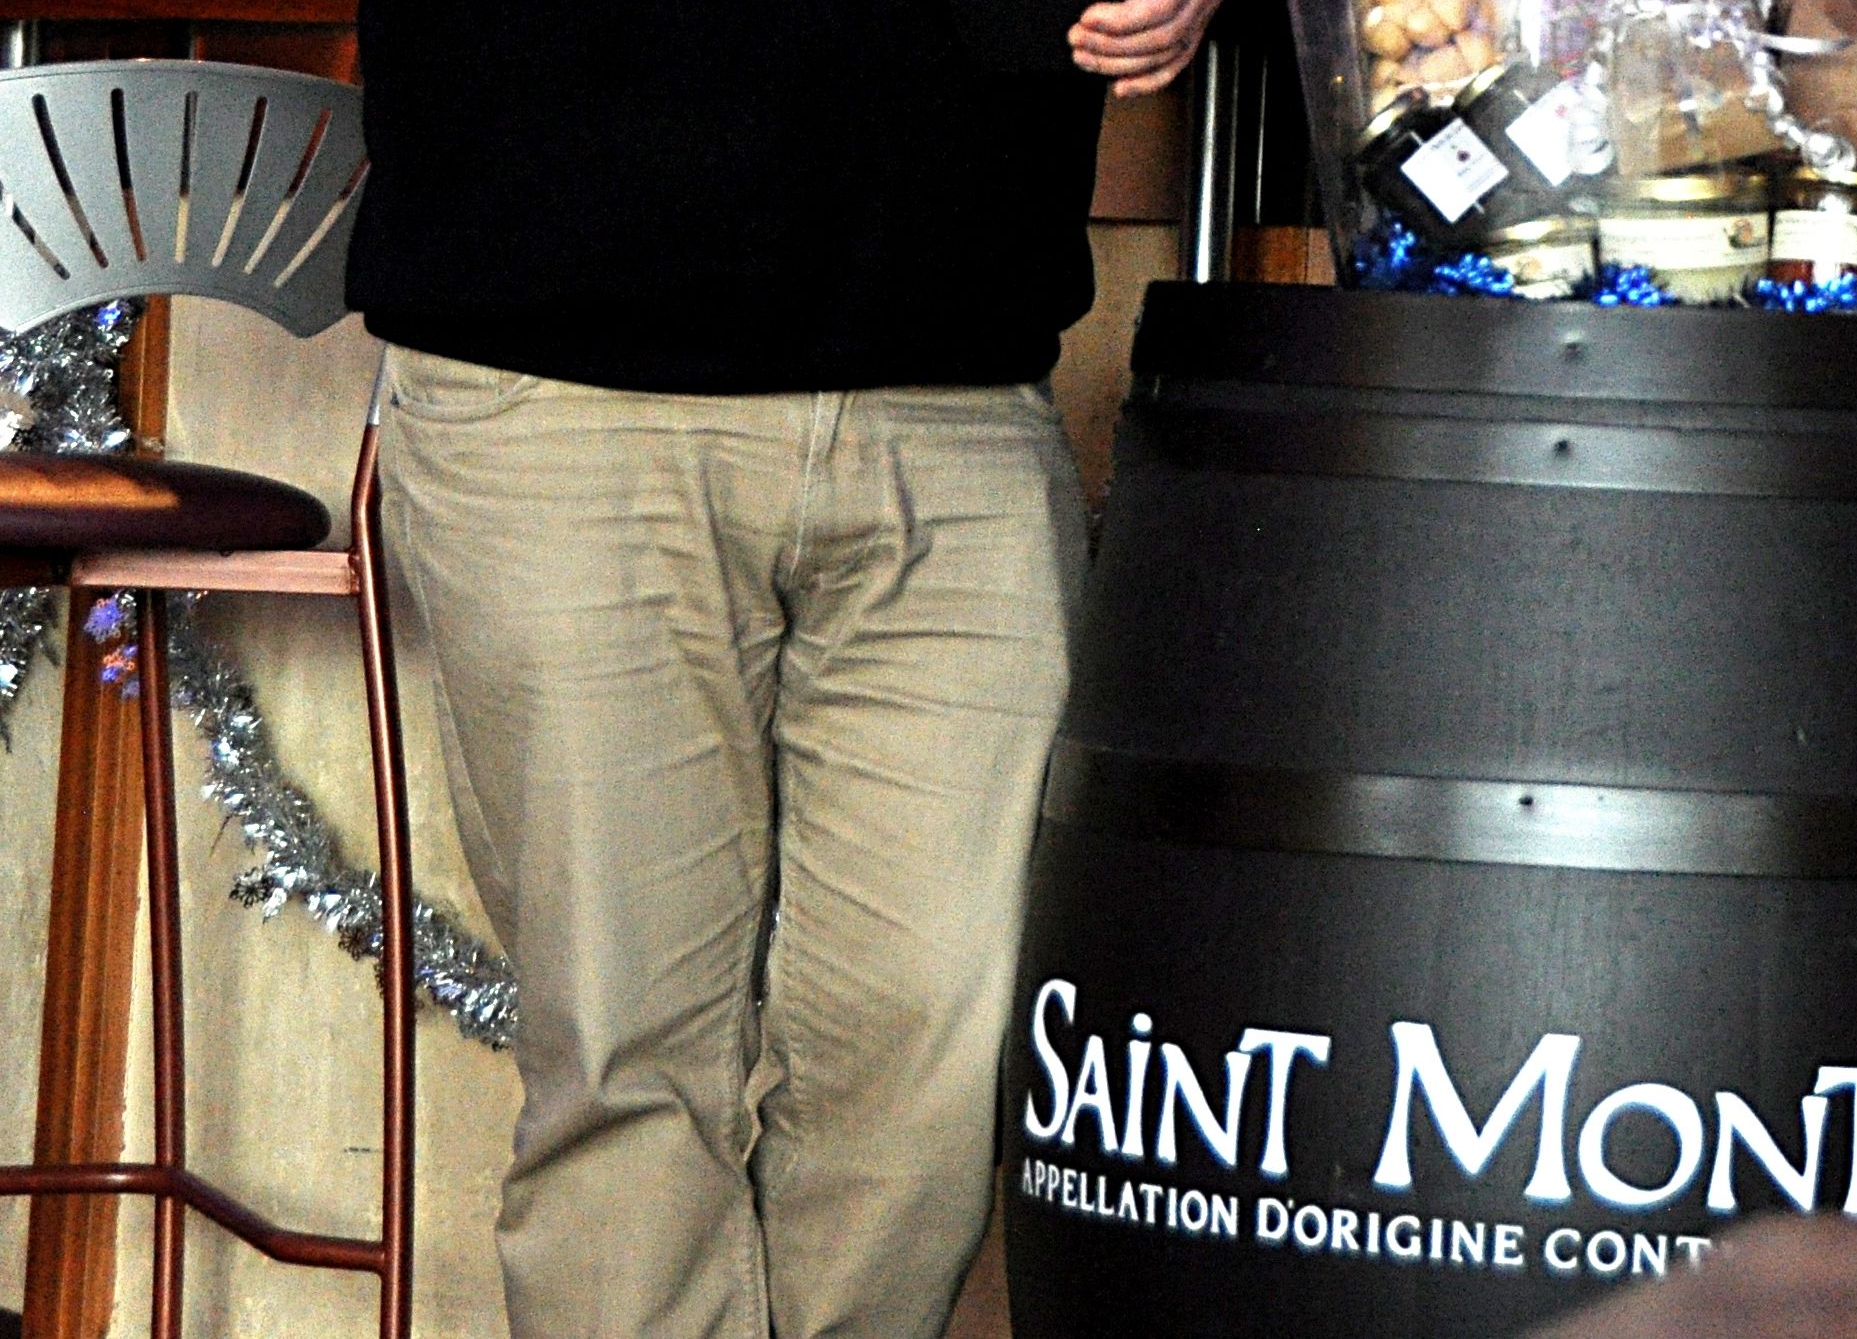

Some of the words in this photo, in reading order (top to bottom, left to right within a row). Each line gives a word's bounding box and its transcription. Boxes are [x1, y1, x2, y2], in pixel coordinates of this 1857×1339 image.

[1022, 1158, 1240, 1237] APPELLATION
[1255, 1196, 1526, 1268] D'ORIGINE
[1543, 1226, 1716, 1279] CONT
